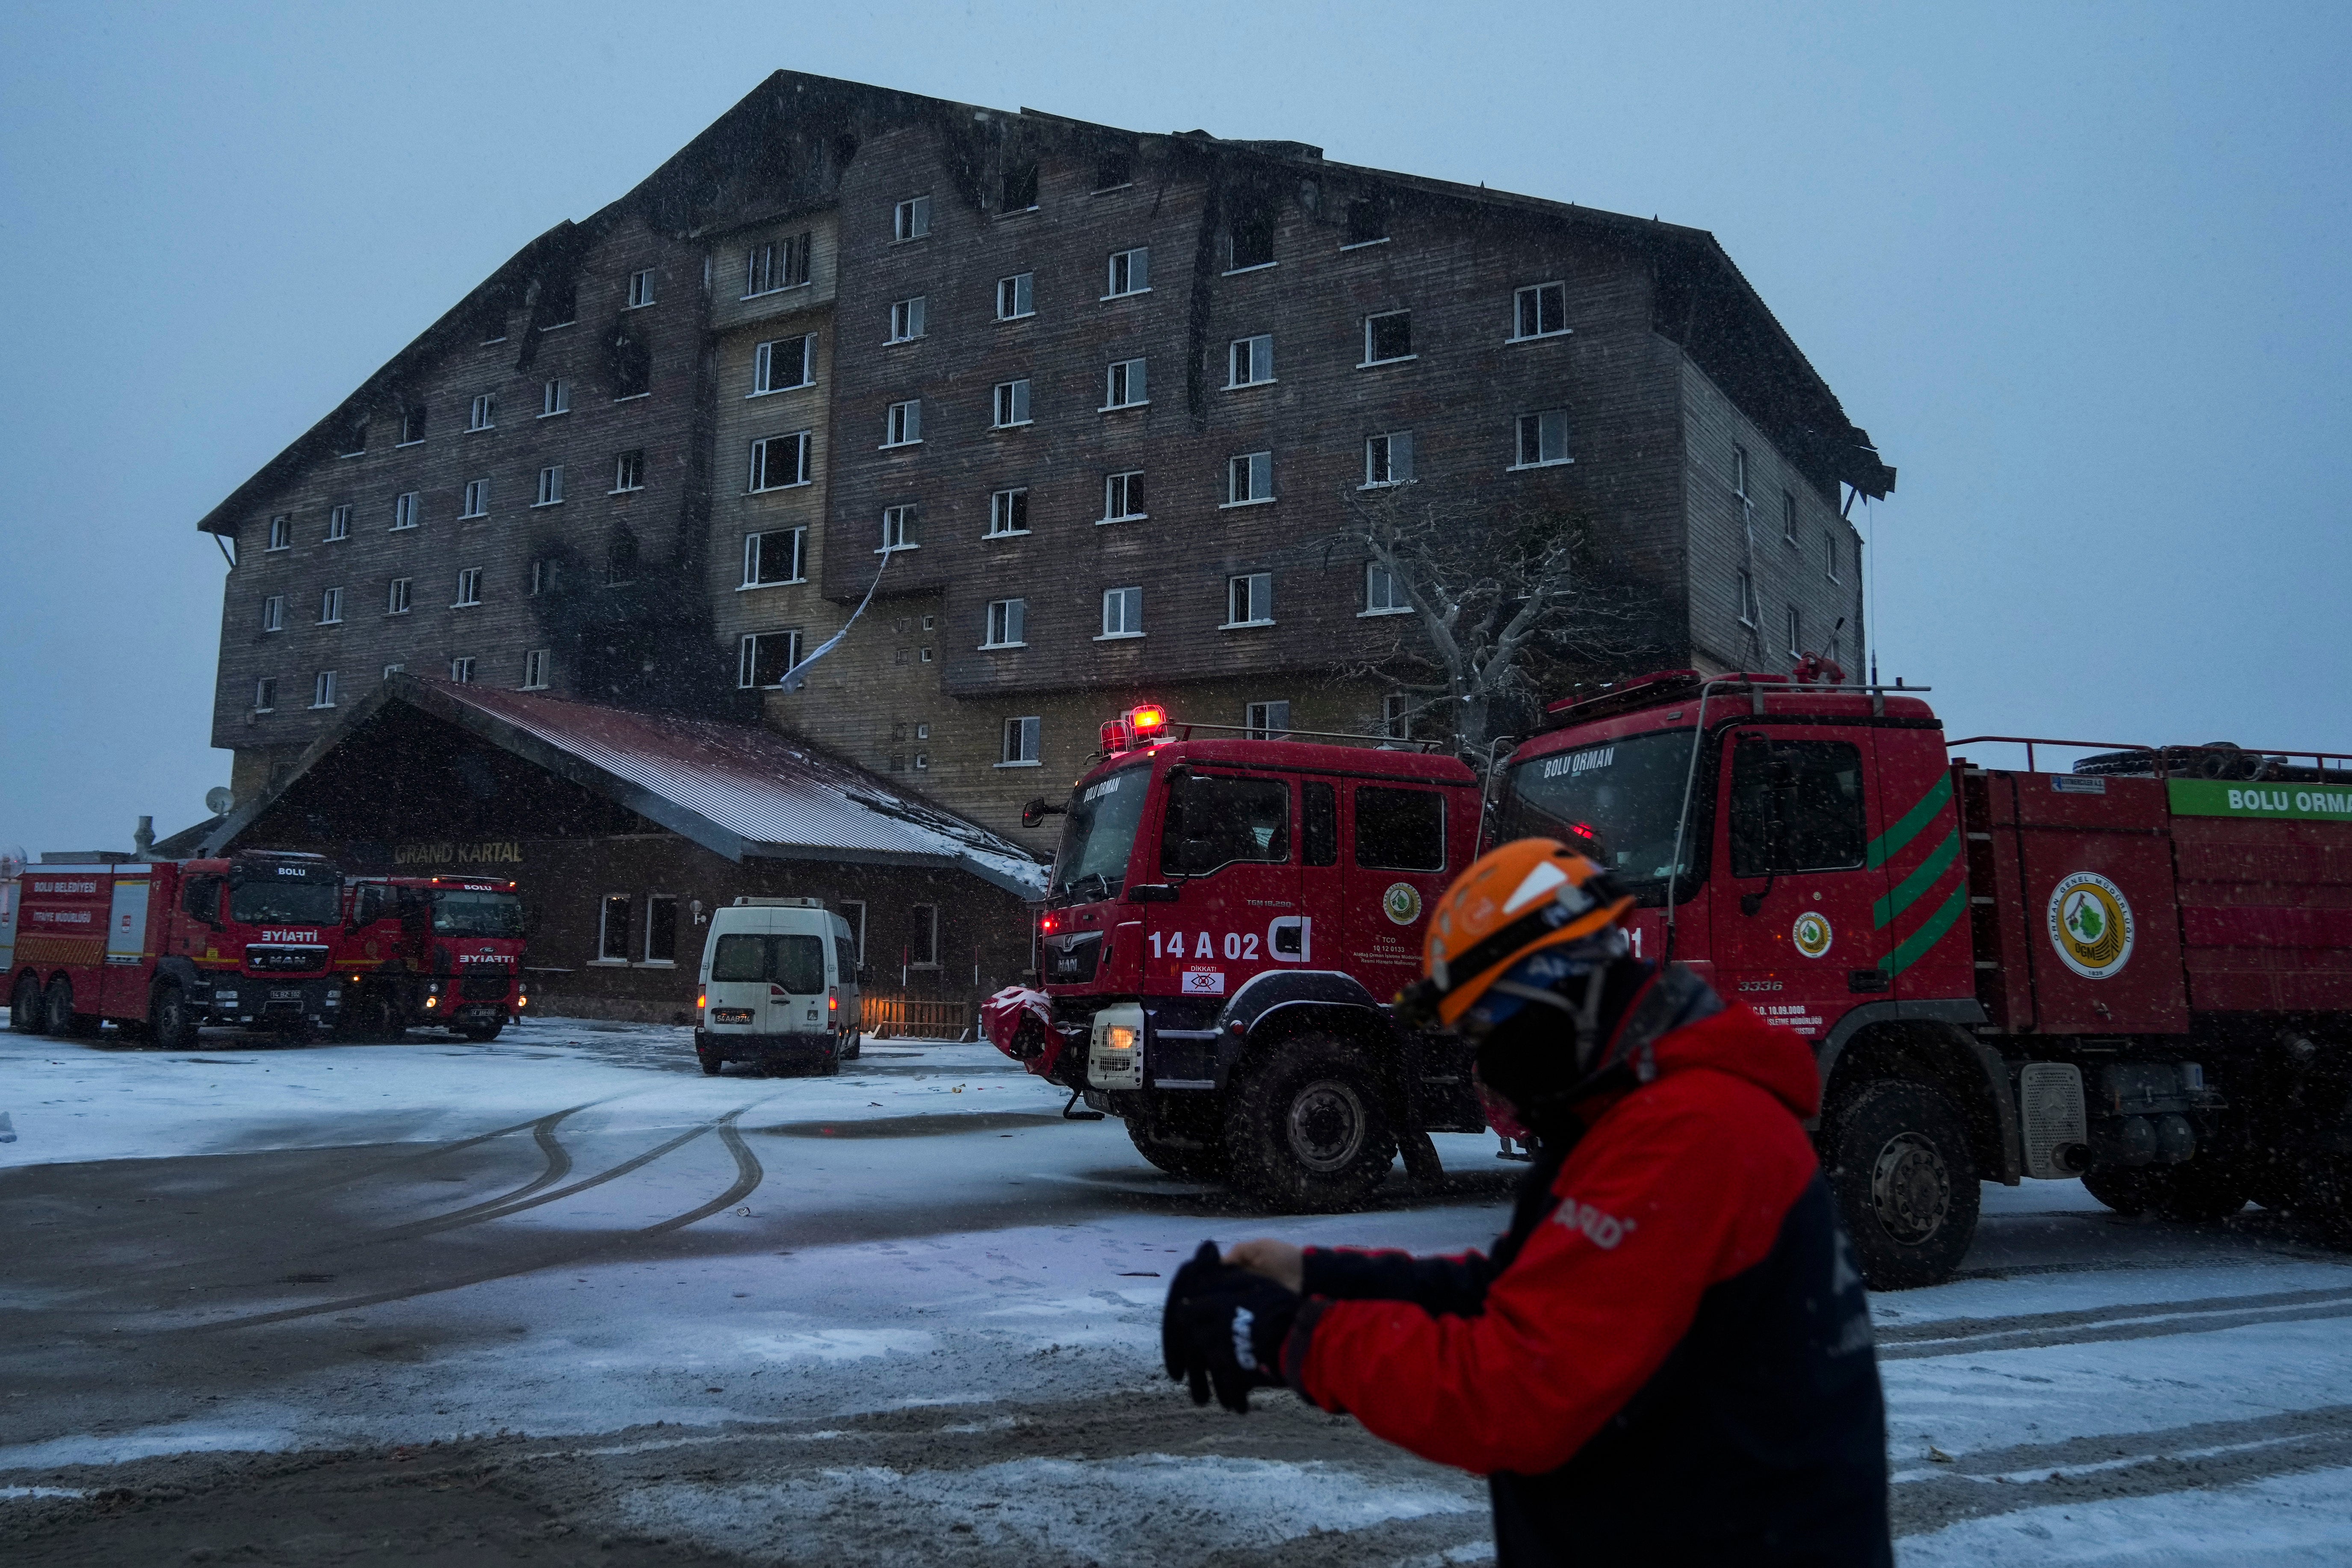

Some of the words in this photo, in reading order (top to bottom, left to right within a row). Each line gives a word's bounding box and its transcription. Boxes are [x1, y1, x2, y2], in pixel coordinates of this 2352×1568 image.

[1544, 756, 1571, 778] BOLU
[1572, 747, 1614, 772] ORMAN
[1084, 784, 1099, 803] BOLU
[1097, 777, 1120, 797] ORMAN
[2228, 789, 2288, 811] BOLU
[394, 842, 453, 864] GRAND
[458, 842, 523, 862] KARTAL
[278, 868, 305, 876] BOLU
[34, 882, 54, 892] BOLU
[2060, 876, 2089, 893] GENEL
[2095, 878, 2132, 943] MÜDÜRLÜĞÜ
[1148, 931, 1185, 958] 14
[1194, 932, 1214, 959] A
[1224, 932, 1259, 960] 02
[2075, 943, 2095, 960] OGM
[1057, 958, 1078, 972] MAN
[1738, 980, 1783, 992] 3336
[1790, 1016, 1823, 1025] MÜDÜRLÜĞÜ
